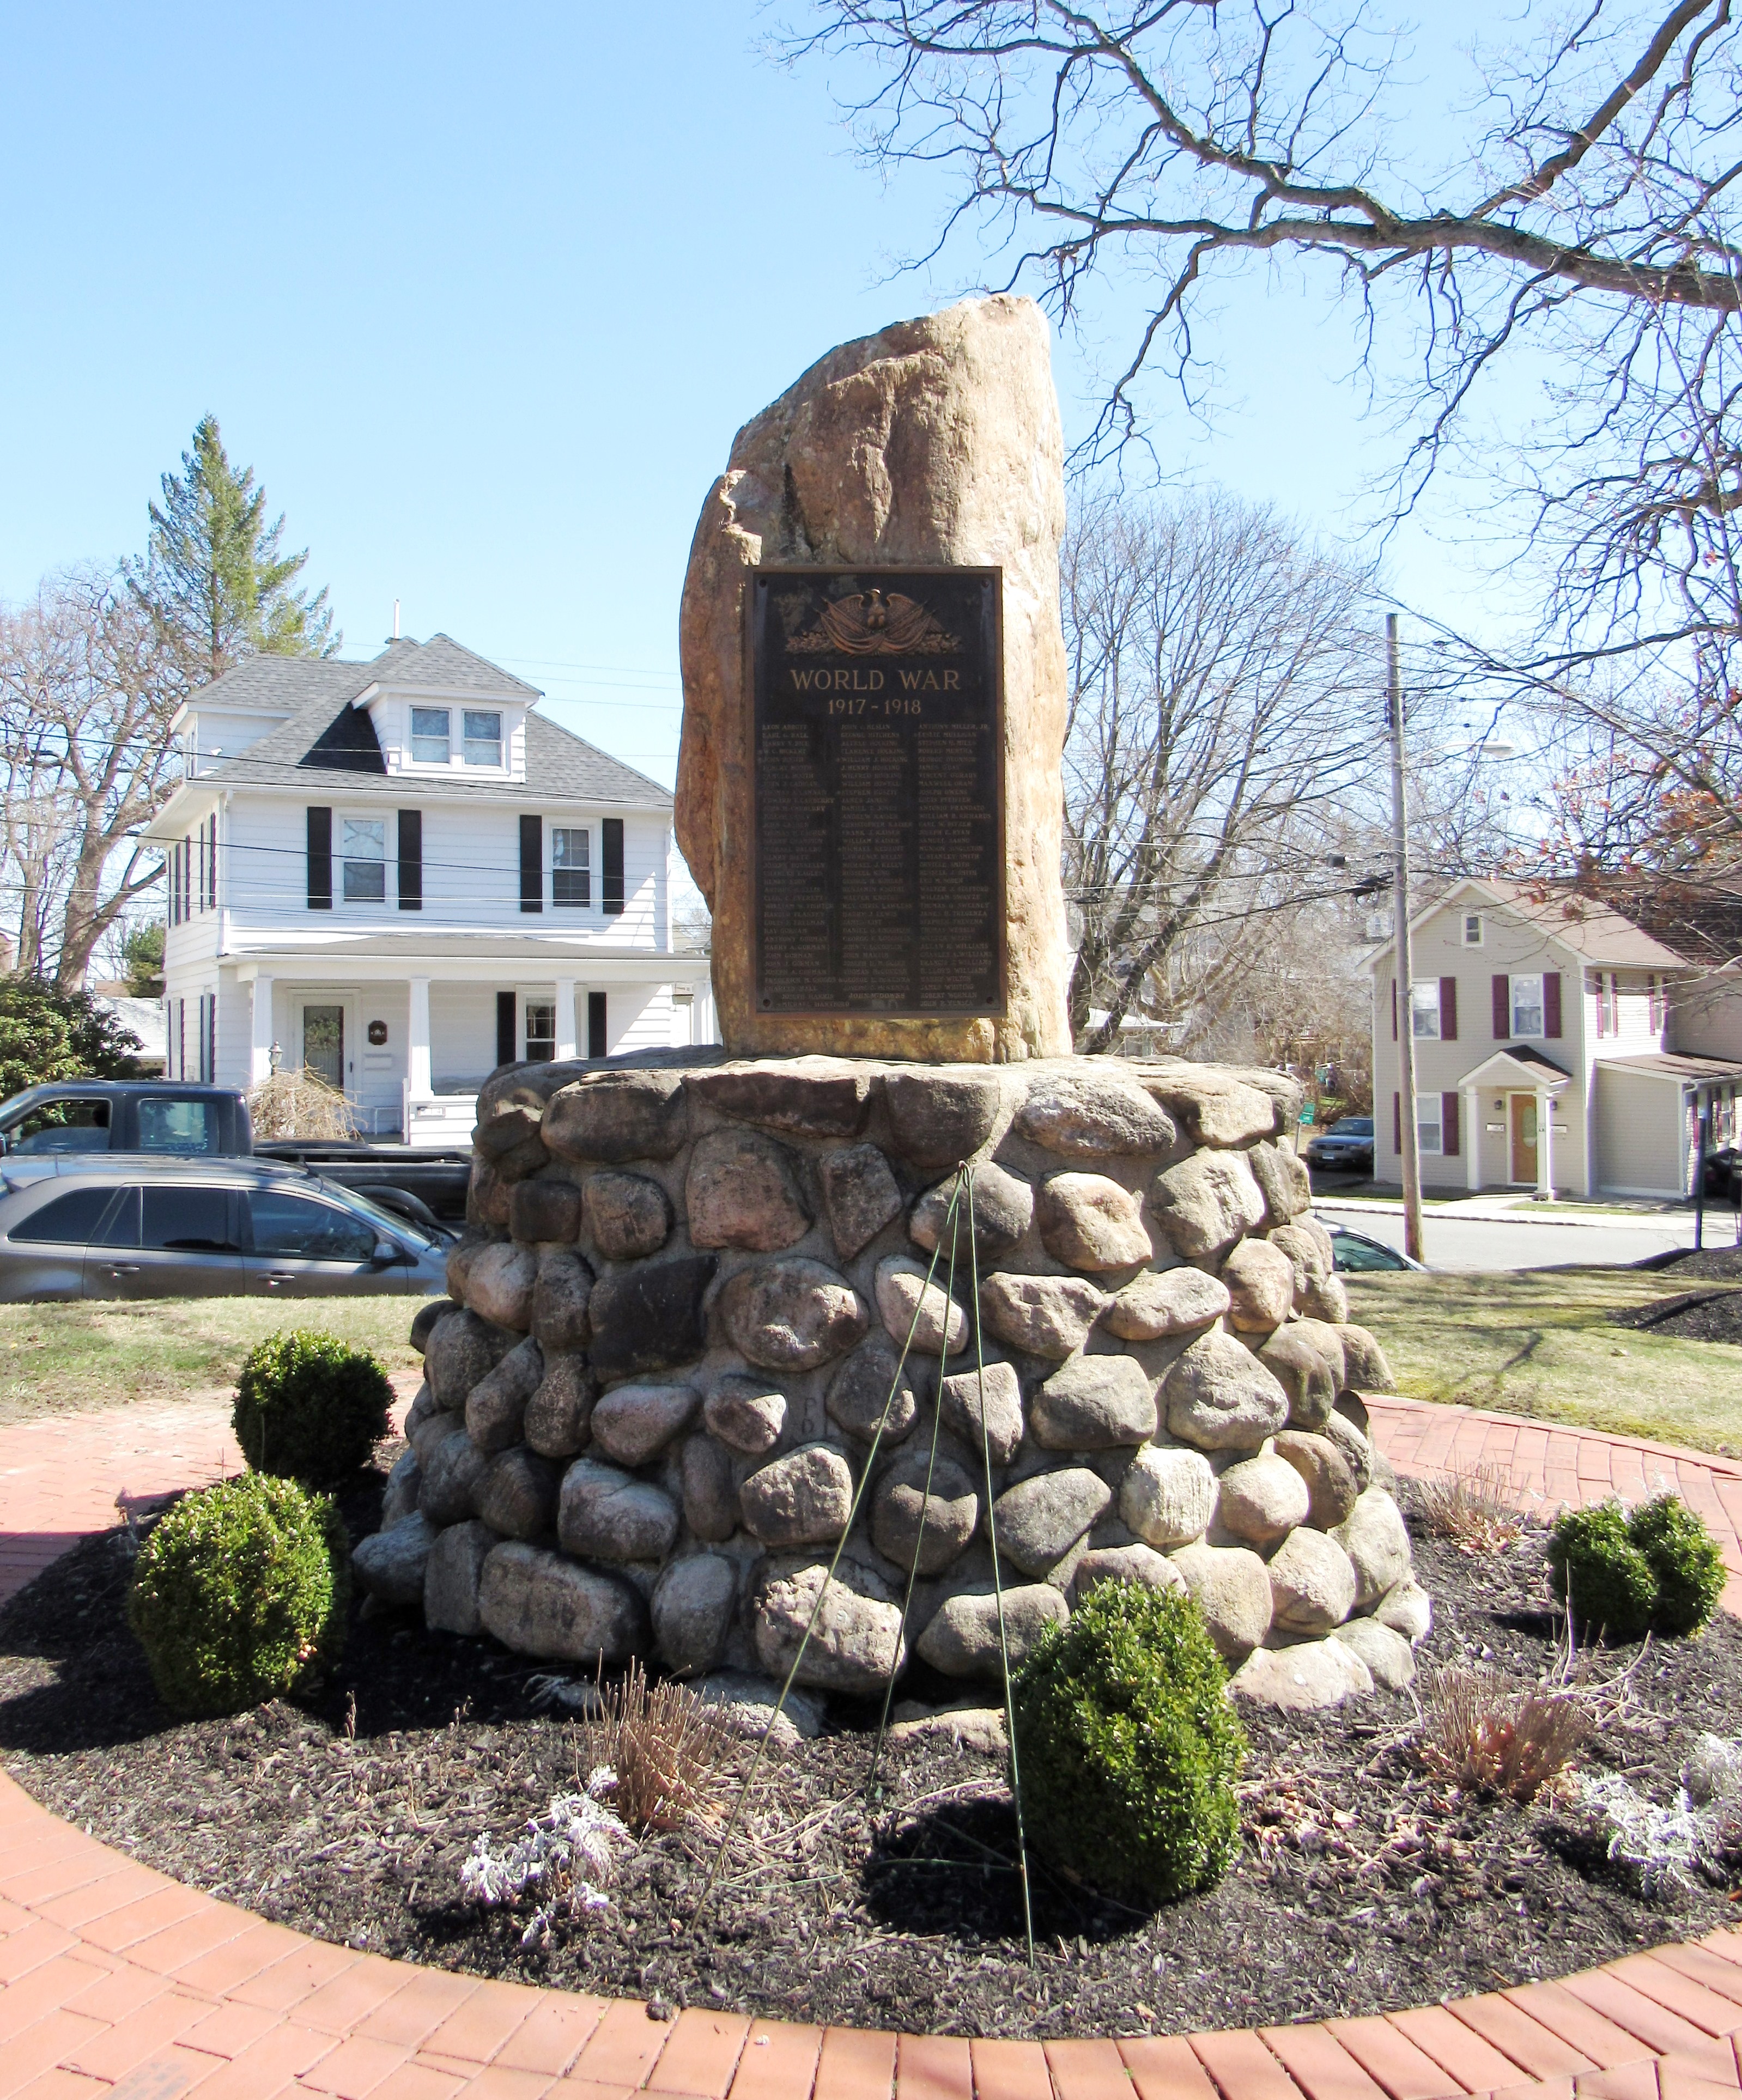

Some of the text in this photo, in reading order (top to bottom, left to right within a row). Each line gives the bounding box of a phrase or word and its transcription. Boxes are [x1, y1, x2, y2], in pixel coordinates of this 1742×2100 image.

[791, 669, 961, 690] WORLD WAR
[829, 699, 865, 715] 1917
[884, 698, 921, 714] 1918
